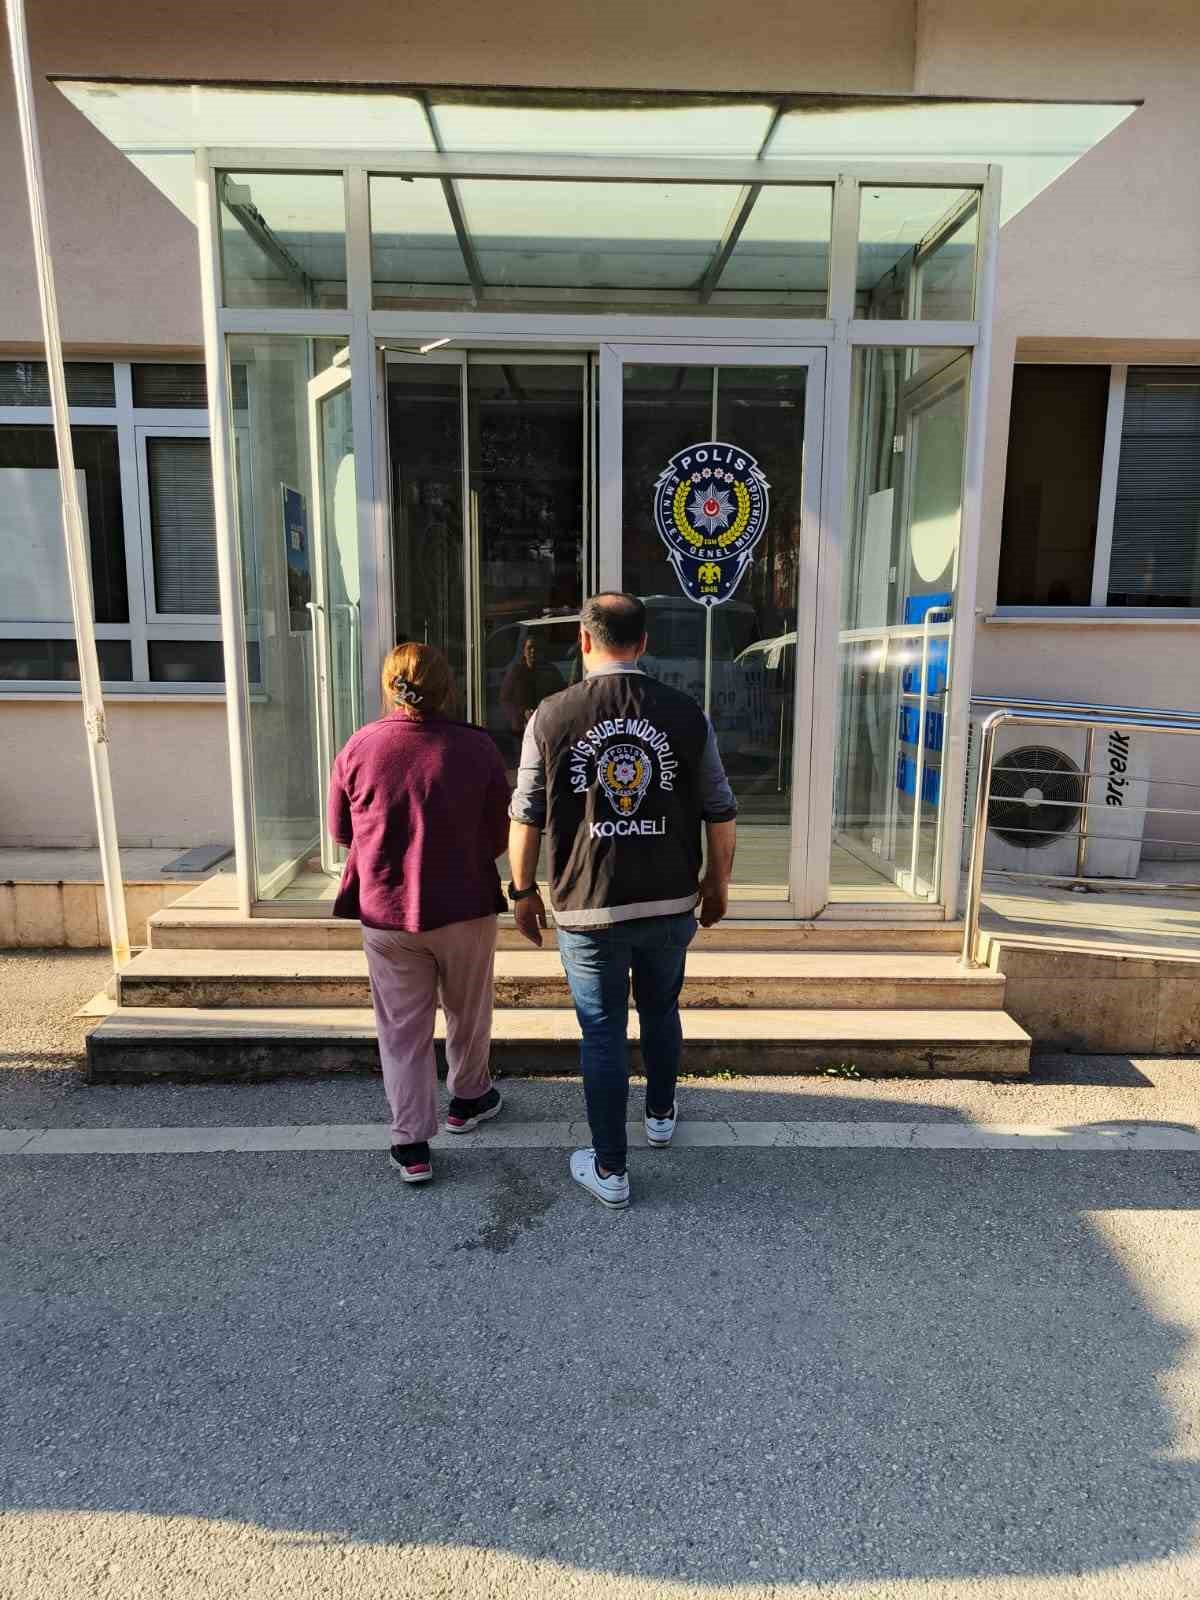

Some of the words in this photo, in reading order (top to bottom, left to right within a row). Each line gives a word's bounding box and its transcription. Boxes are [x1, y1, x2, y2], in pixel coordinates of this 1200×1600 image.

[681, 449, 746, 471] POLİS
[570, 740, 596, 793] ASAYİŞ
[586, 718, 625, 747] ŞUBE
[1105, 731, 1130, 806] arçelik
[588, 816, 666, 838] KOCAELİ
